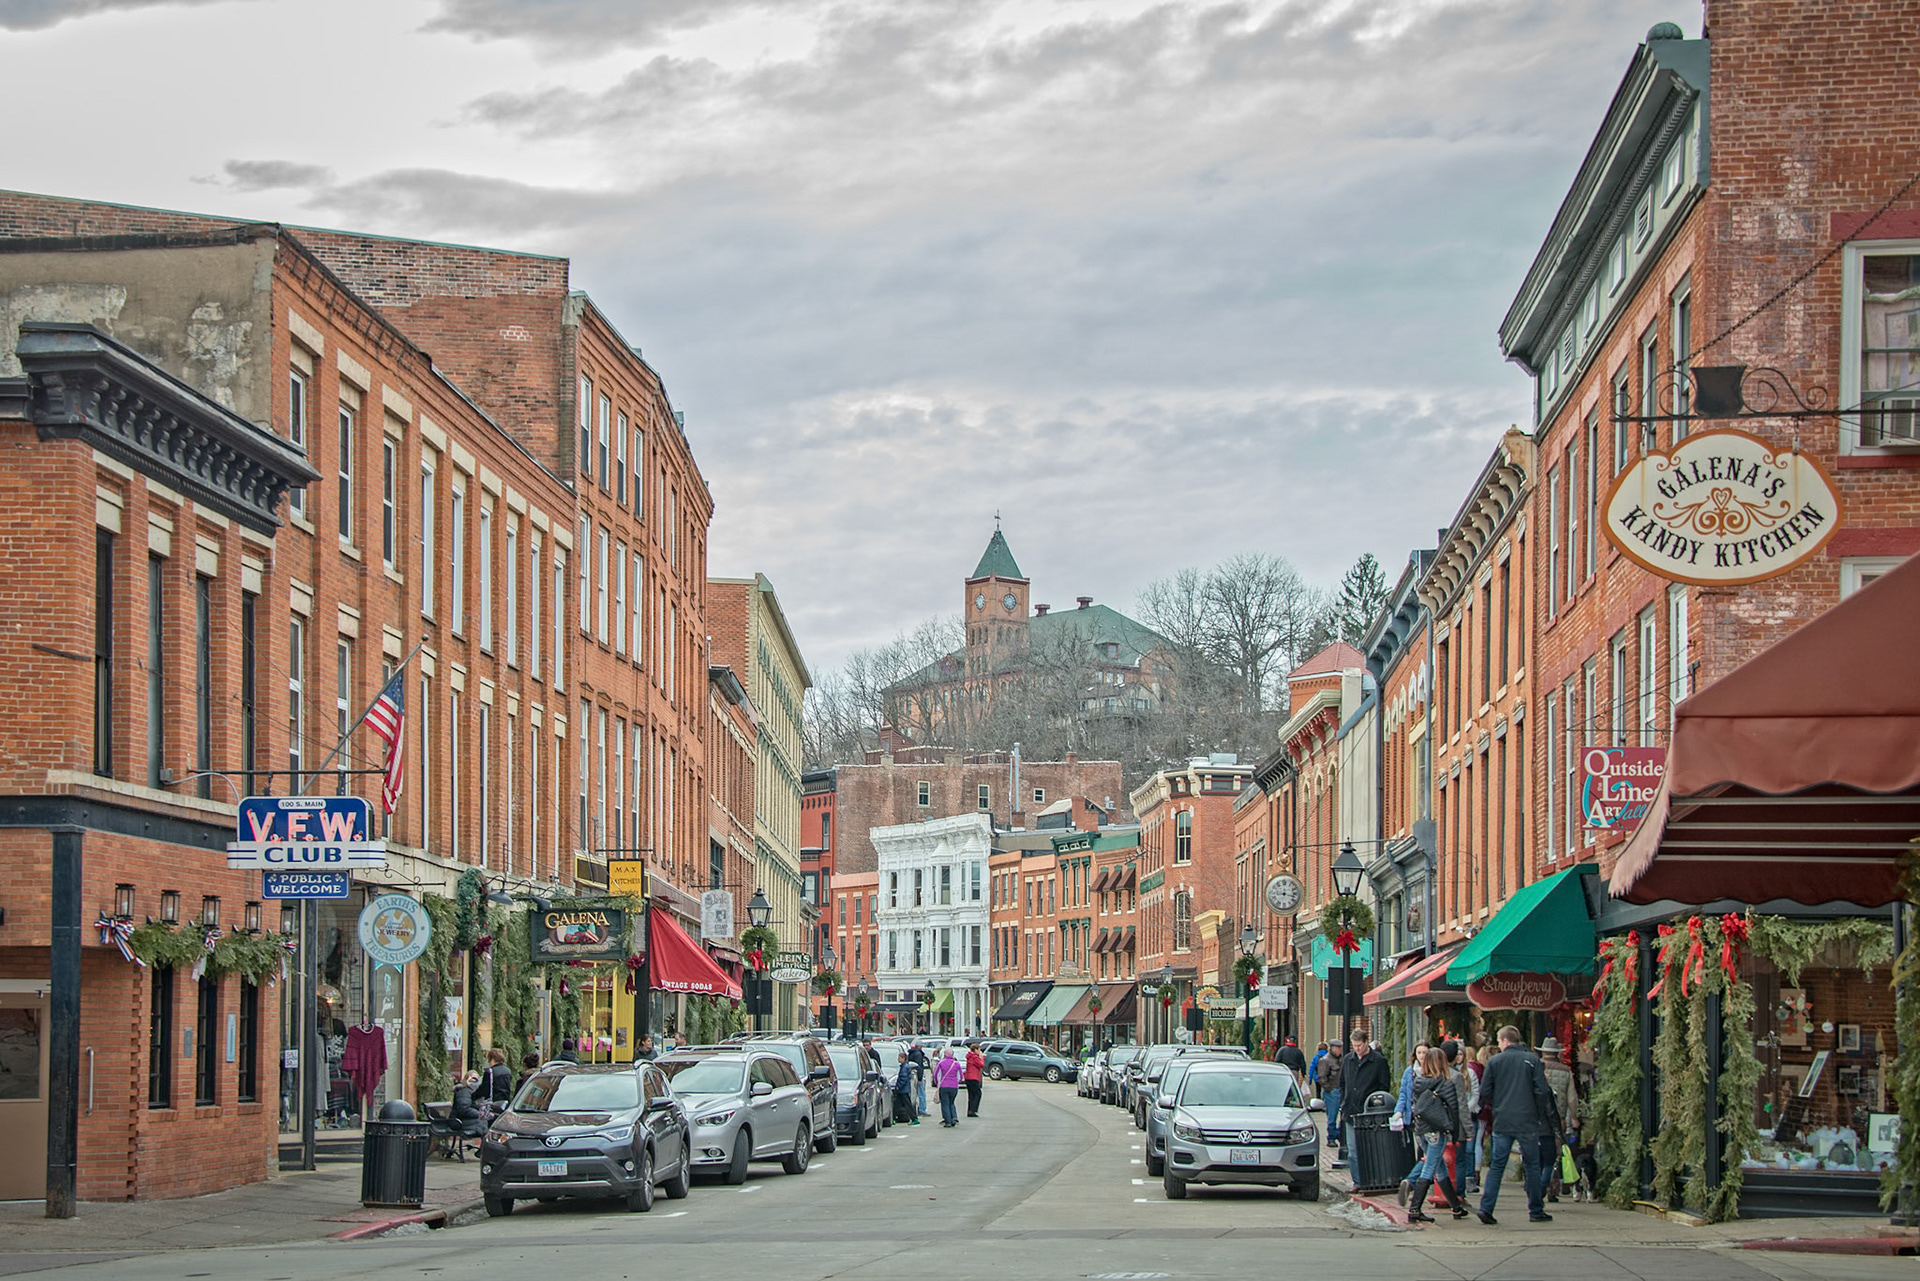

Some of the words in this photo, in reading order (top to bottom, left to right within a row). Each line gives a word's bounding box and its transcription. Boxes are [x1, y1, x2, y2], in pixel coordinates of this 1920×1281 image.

[1657, 456, 1787, 500] GALENA'S
[1619, 504, 1705, 565] KANDY
[1713, 501, 1826, 568] KITCHEN
[1584, 749, 1664, 777] Outside
[264, 847, 342, 863] CLUB
[280, 874, 332, 884] PUBLIC
[270, 884, 342, 895] WELCOME
[376, 896, 419, 913] EARTH'S
[544, 911, 611, 930] GALENA
[365, 938, 422, 963] TREASURES
[661, 979, 689, 989] VINTAGE
[691, 983, 713, 991] SODAS
[1482, 974, 1552, 1000] Strawberry
[1510, 990, 1545, 1007] Lane
